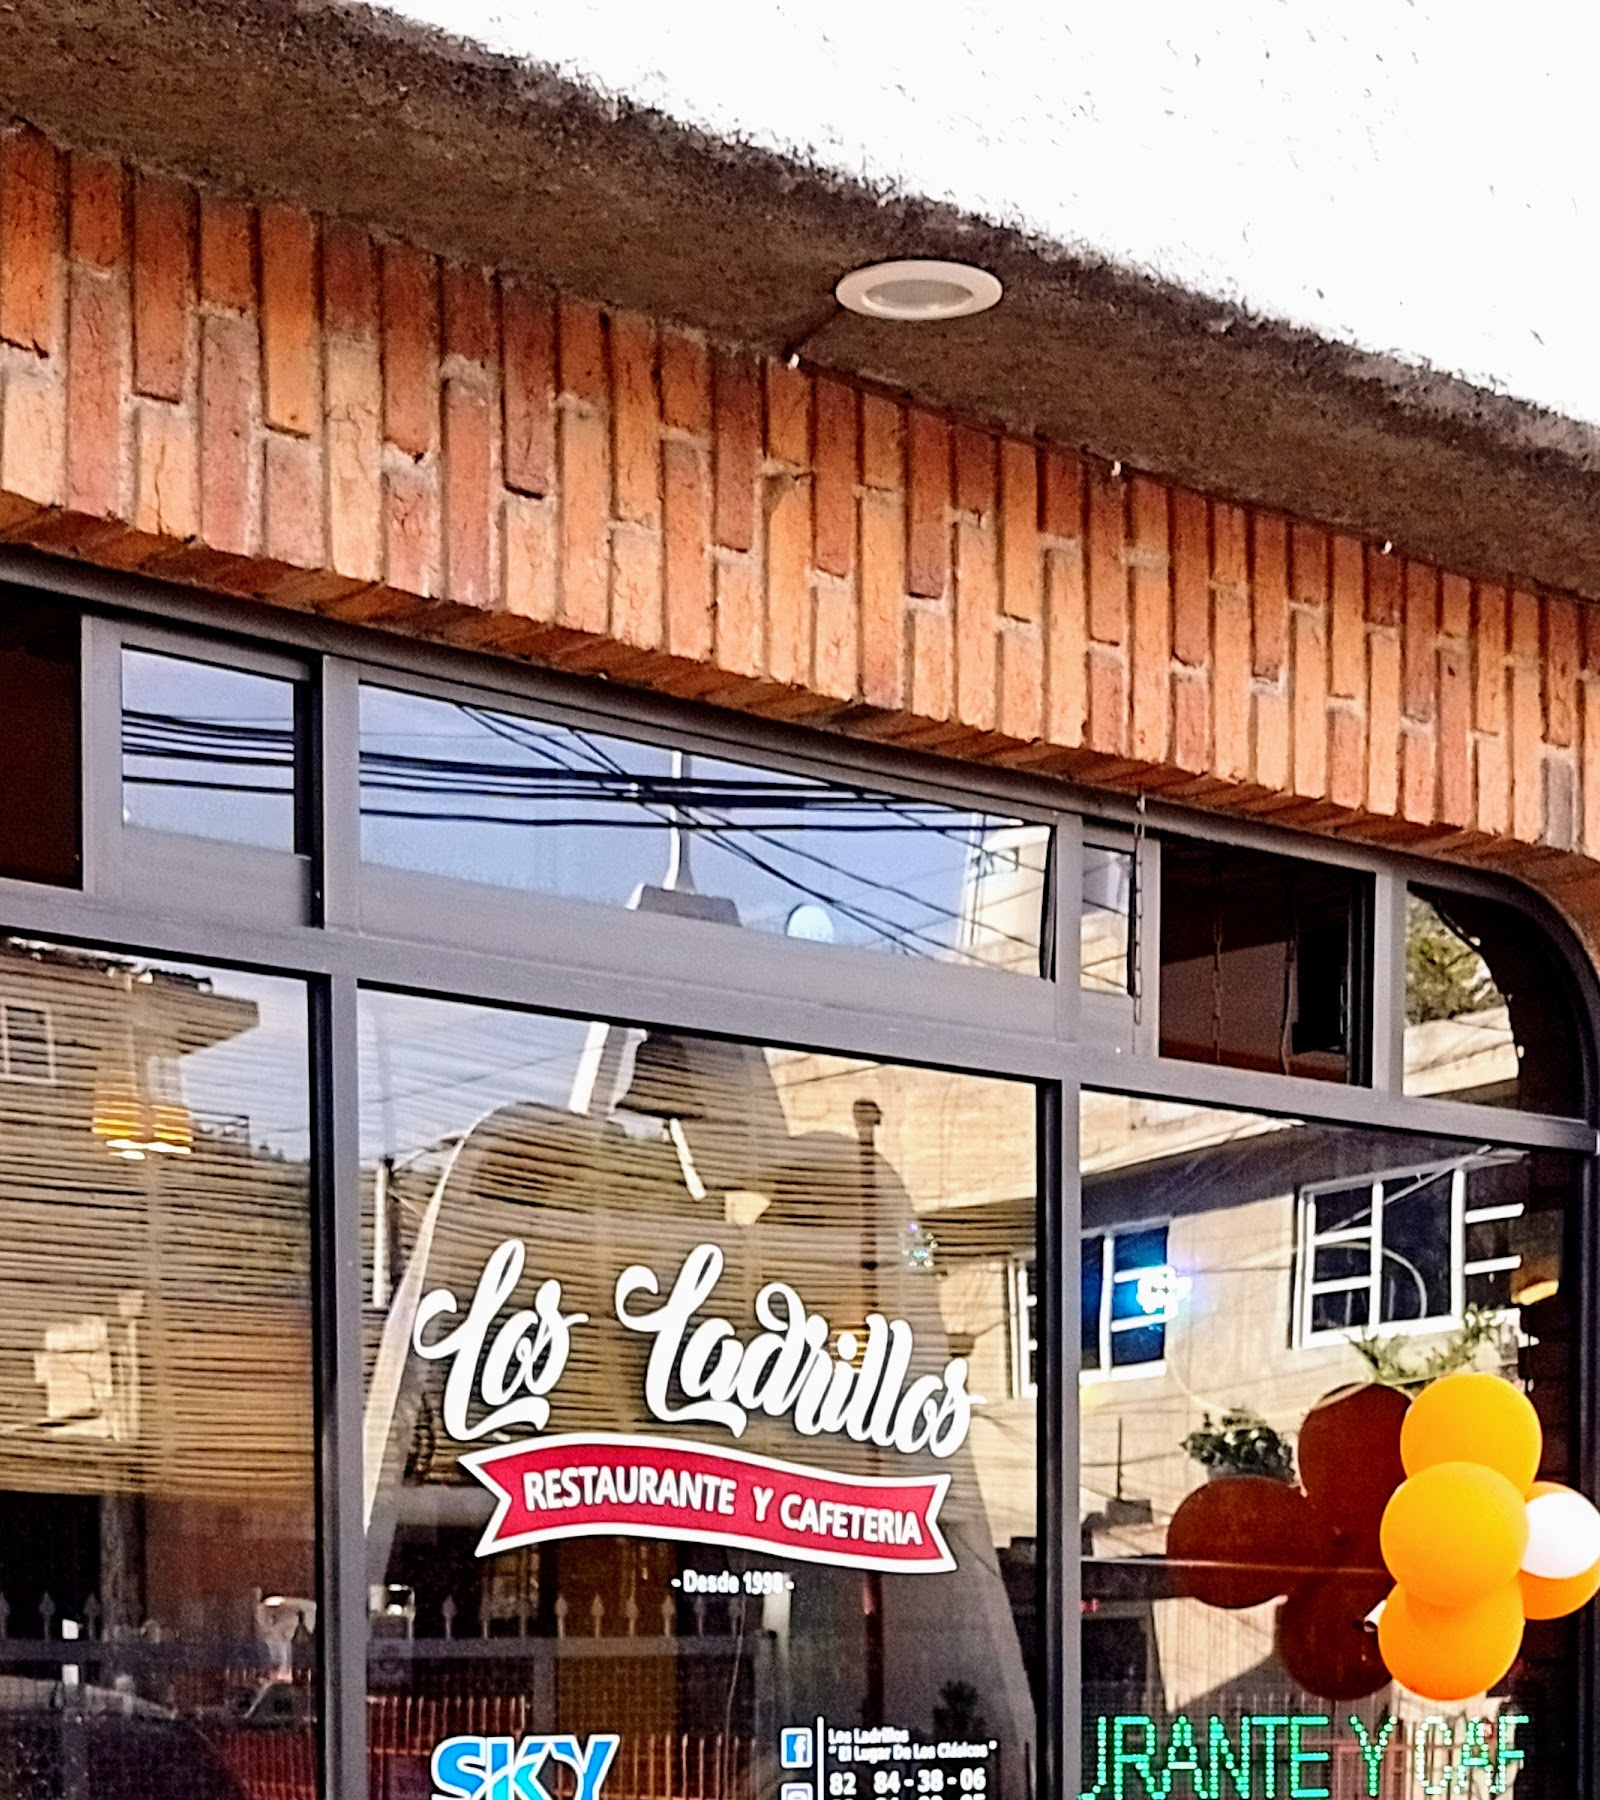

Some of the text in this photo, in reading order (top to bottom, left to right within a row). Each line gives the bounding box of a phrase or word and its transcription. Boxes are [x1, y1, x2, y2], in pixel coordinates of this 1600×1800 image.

[413, 1238, 990, 1460] Los Ladrillos
[522, 1465, 925, 1548] RESTAURANTE Y CAFETERIA
[828, 1728, 852, 1745] Los
[1349, 1713, 1399, 1798] Y
[829, 1771, 858, 1796] 82
